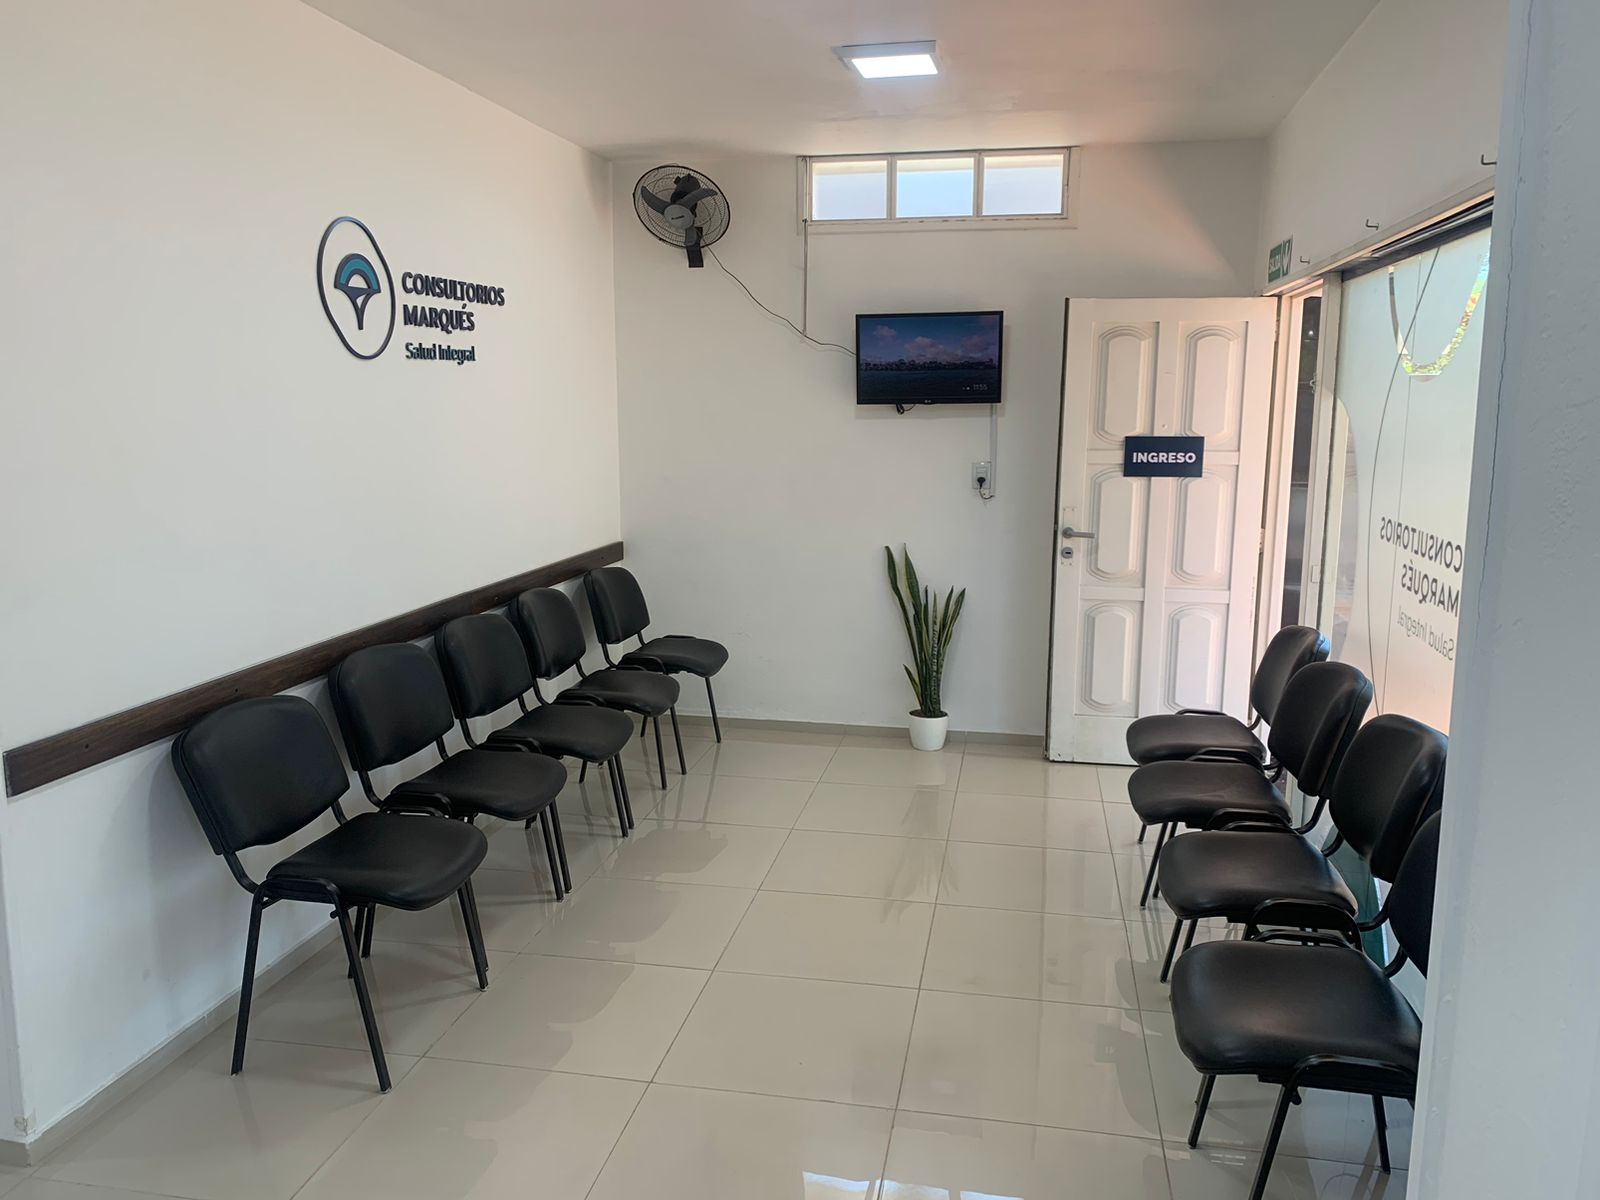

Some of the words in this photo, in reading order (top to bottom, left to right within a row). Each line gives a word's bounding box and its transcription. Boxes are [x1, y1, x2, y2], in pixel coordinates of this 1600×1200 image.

[401, 271, 505, 306] CONSULTORIOS
[402, 303, 476, 334] MARQUÉS
[405, 342, 437, 361] Salud
[438, 344, 476, 365] Integral
[1131, 451, 1197, 464] INGRESO
